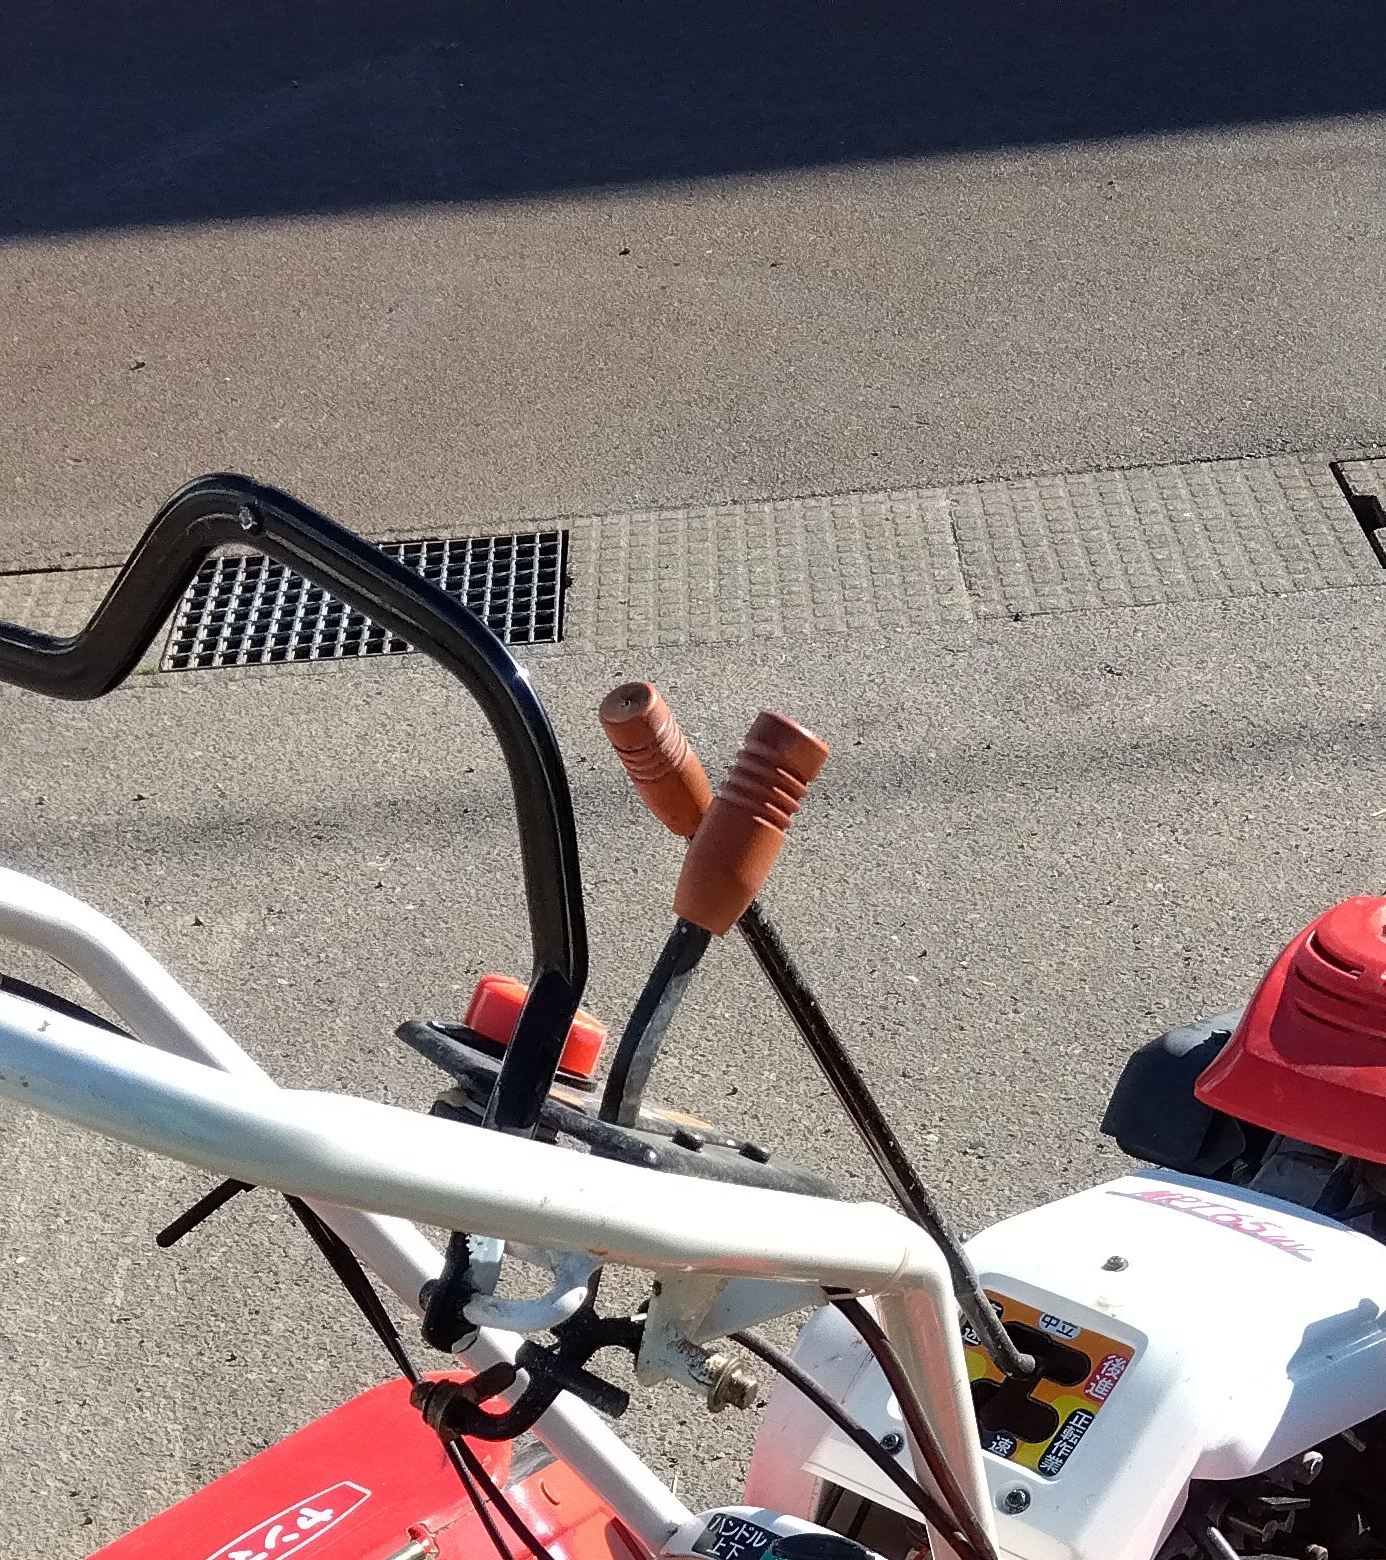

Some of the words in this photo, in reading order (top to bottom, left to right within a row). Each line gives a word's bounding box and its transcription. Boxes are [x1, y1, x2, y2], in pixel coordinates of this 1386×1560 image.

[1040, 1314, 1076, 1339] 中立
[1085, 1354, 1131, 1401] 後進
[1039, 1410, 1094, 1476] 正転作業
[707, 1536, 745, 1560] 上下
[708, 1514, 768, 1549] ハンドル
